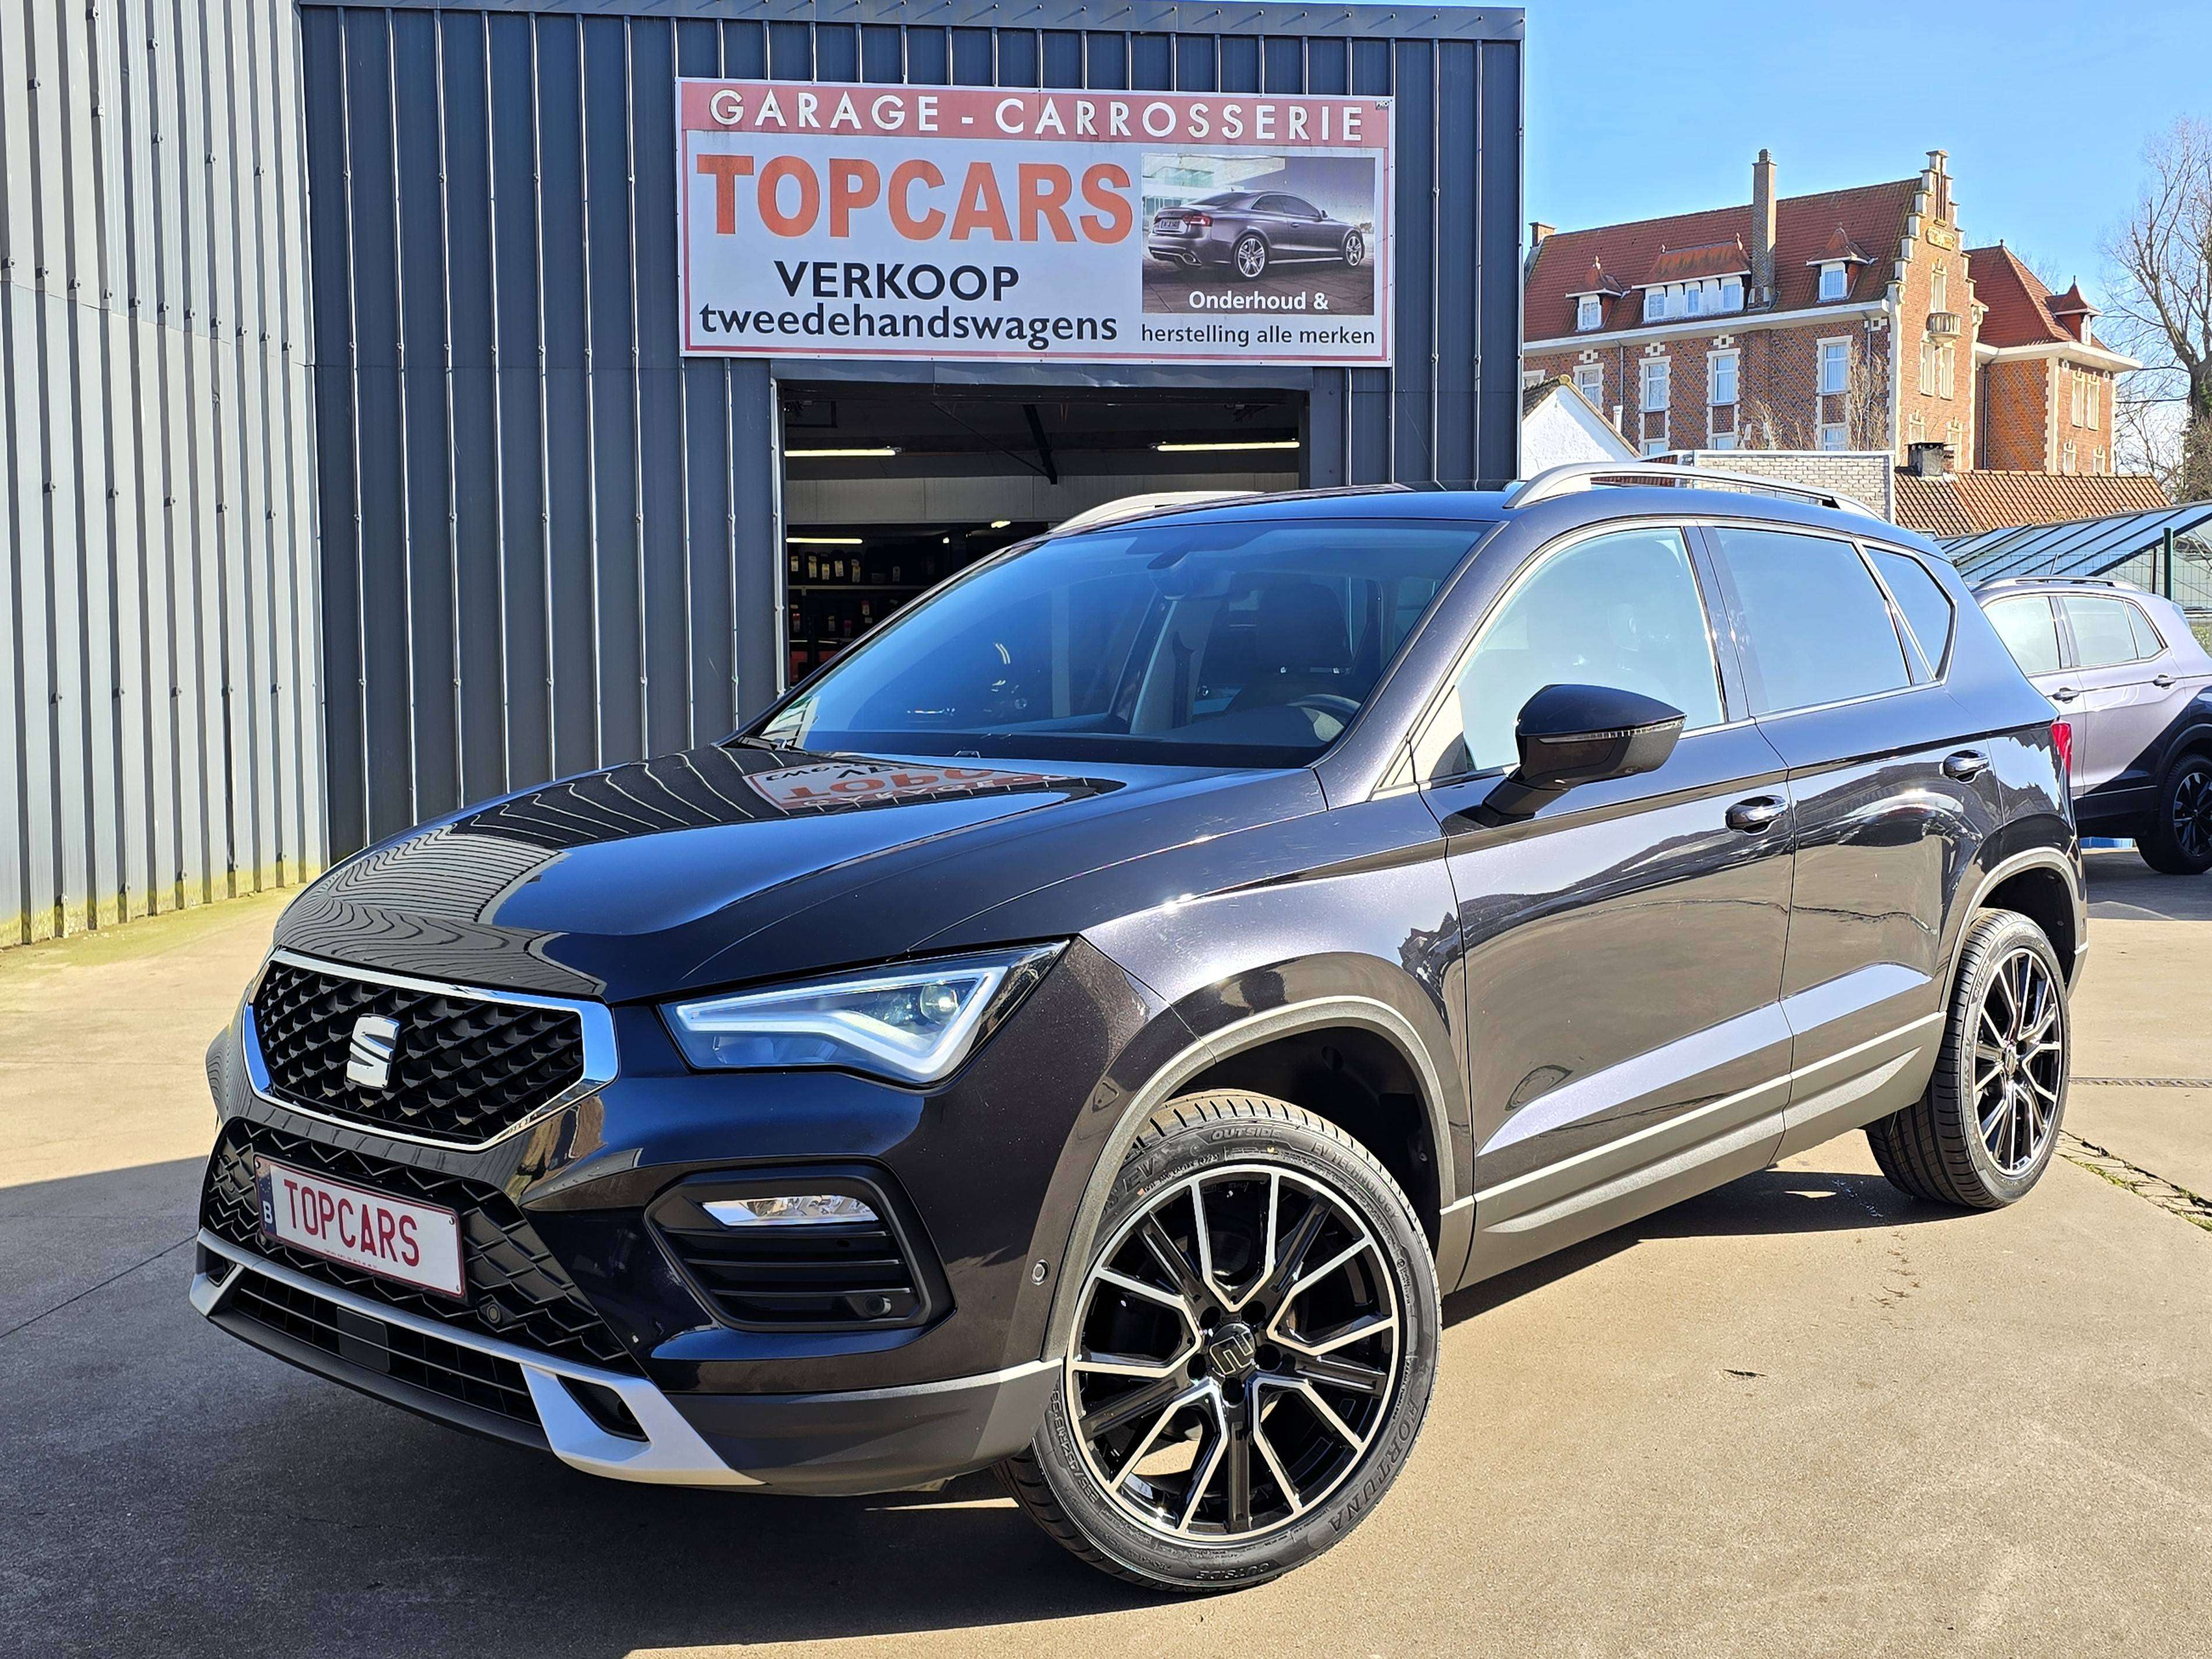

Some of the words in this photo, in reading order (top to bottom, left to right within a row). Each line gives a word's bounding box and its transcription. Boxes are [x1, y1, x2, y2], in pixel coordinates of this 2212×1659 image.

[709, 88, 938, 131] GARAGE
[995, 97, 1362, 141] CARROSSERIE
[696, 154, 1133, 244] TOPCARS
[774, 261, 1019, 301] VERKOOP
[1189, 290, 1306, 310] Onderhoud
[1313, 292, 1329, 310] &
[699, 302, 1117, 350] tweedehandswagens
[1142, 324, 1249, 348] herstelling
[1257, 325, 1292, 343] alle
[1299, 325, 1375, 345] merken
[1211, 1128, 1281, 1140] OUTSIDE
[262, 1200, 274, 1225] B
[283, 1178, 420, 1267] TOPCARS
[1328, 1398, 1419, 1533] FORTUNA
